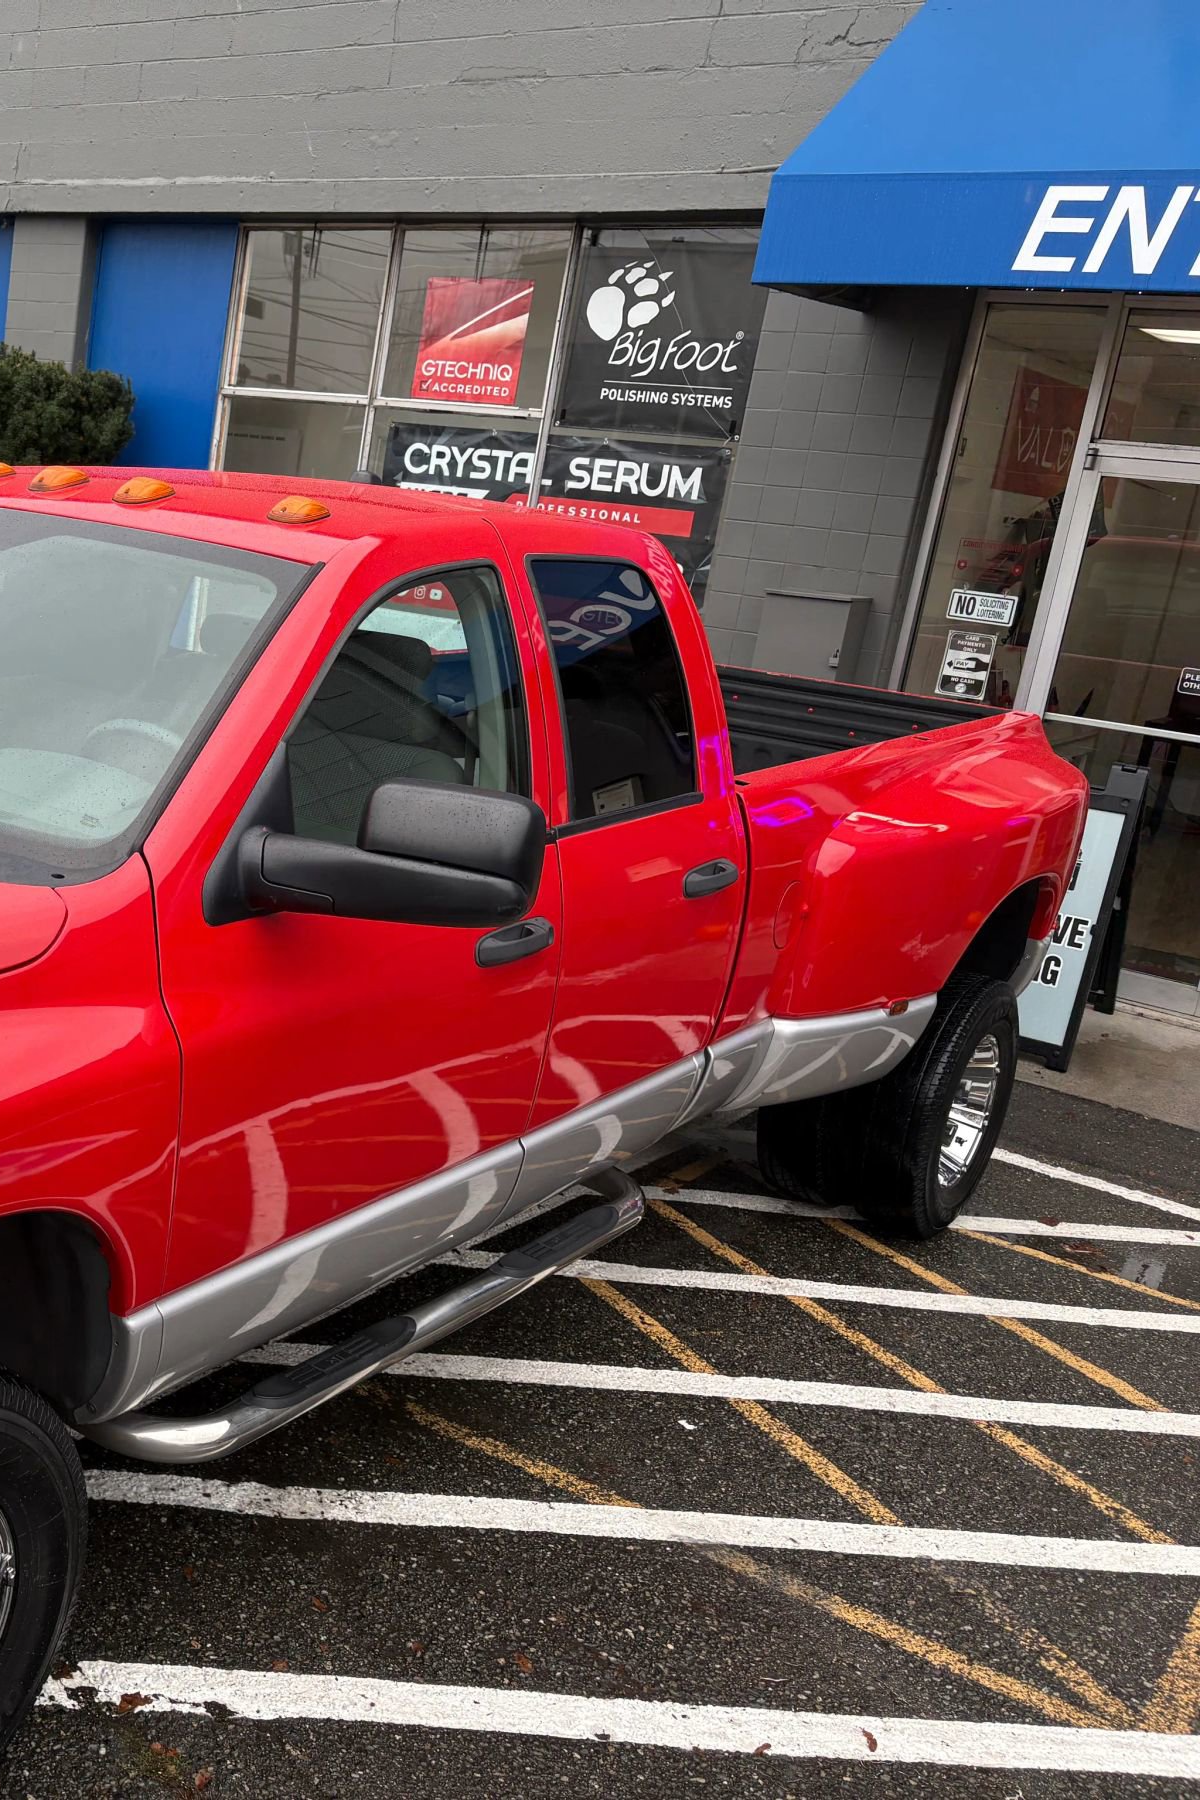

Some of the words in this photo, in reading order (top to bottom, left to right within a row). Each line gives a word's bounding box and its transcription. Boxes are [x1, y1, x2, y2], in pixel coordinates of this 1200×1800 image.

[1010, 184, 1200, 276] EN
[421, 359, 513, 381] GTECHNIQ
[432, 382, 509, 397] ACCREDITED
[600, 387, 669, 405] POLISHING
[670, 392, 733, 409] SYSTEMS
[567, 456, 703, 501] SERUM
[954, 594, 977, 616] NO
[979, 597, 1009, 611] SOLICITING
[976, 608, 1005, 620] LOITERING
[957, 640, 986, 648] PAYMENTS
